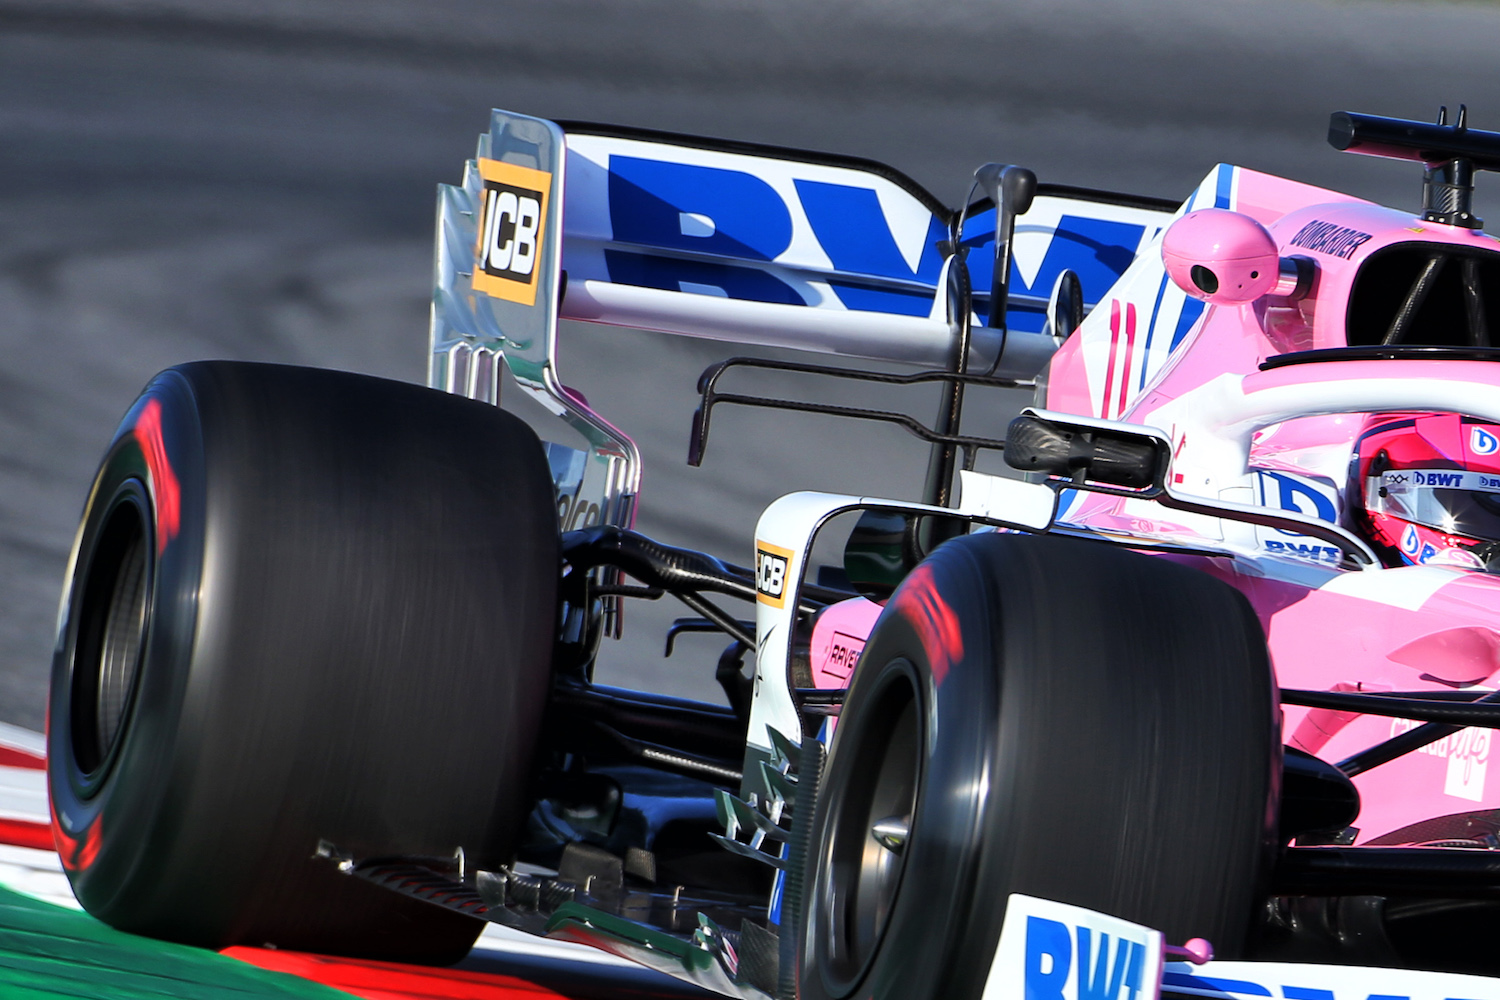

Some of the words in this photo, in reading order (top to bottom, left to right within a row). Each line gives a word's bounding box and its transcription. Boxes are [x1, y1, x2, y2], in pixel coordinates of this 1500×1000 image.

[603, 154, 1164, 333] BW
[1290, 219, 1373, 261] BOMBARDIER
[1101, 298, 1137, 420] 11
[1427, 474, 1463, 487] BWT
[1264, 540, 1340, 563] BWT
[830, 644, 862, 669] RAVE
